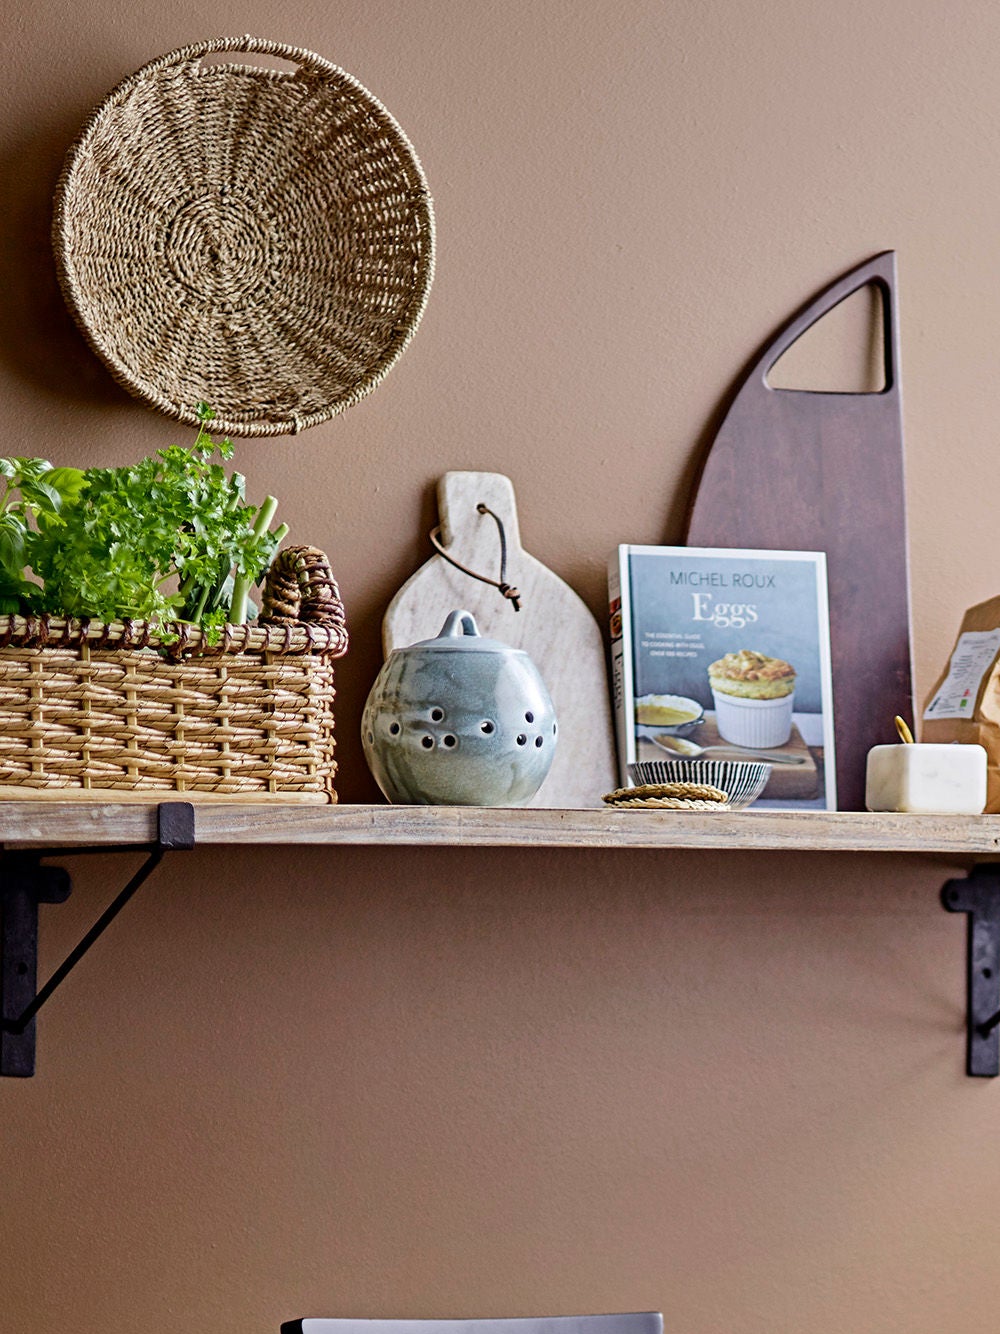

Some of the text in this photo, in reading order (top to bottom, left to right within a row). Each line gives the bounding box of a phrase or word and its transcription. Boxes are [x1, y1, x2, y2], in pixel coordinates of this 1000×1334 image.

[670, 571, 776, 588] MICHEL ROUX
[691, 593, 759, 628] Eggs
